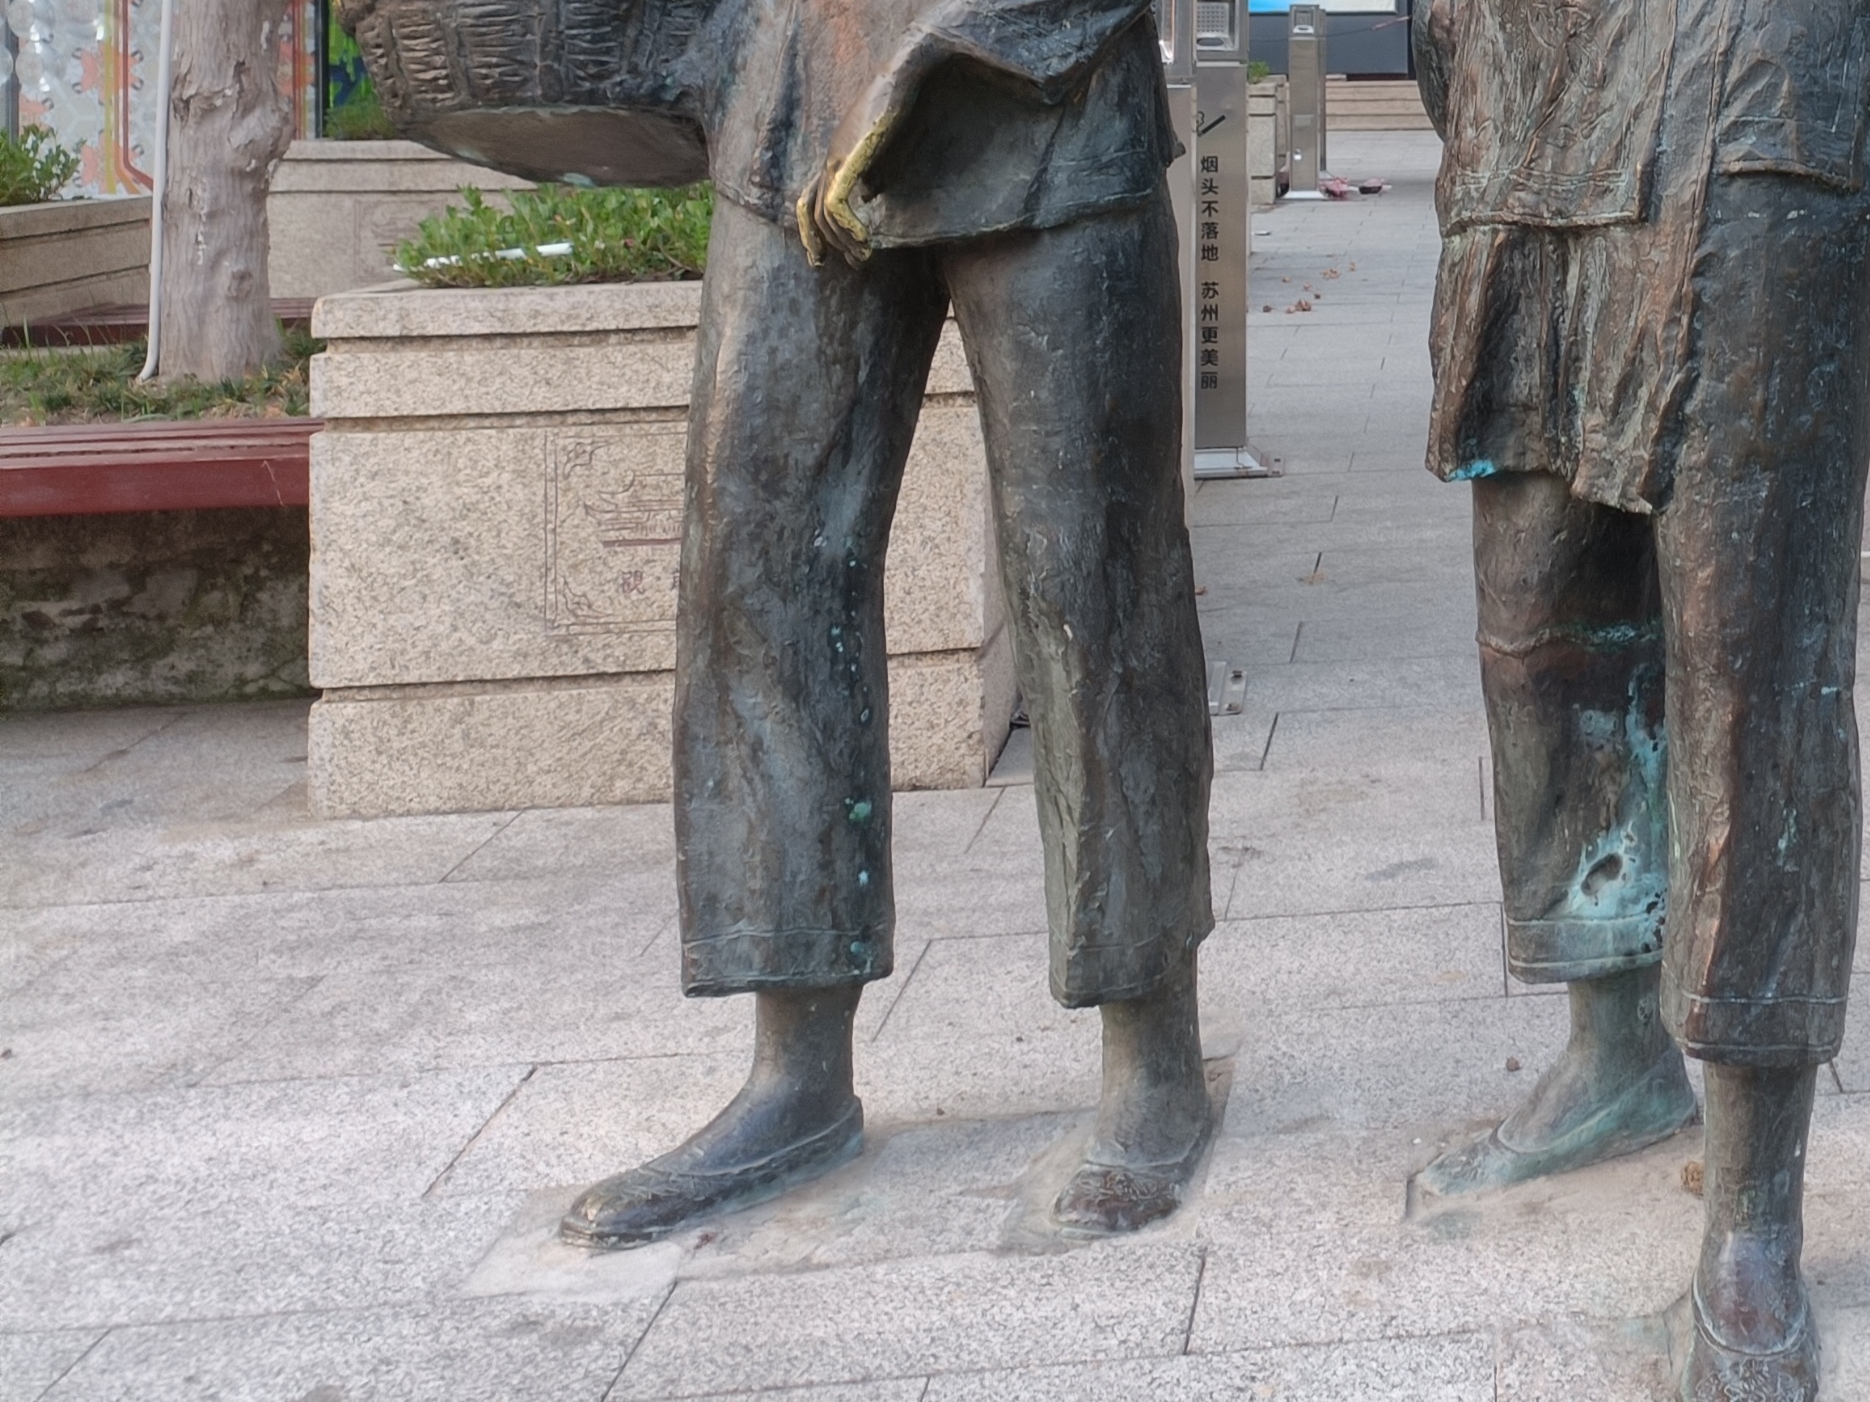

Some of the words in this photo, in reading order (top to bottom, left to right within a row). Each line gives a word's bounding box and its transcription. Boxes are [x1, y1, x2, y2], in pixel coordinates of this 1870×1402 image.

[1200, 155, 1219, 262] 烟头不落地
[1200, 281, 1219, 390] 苏州更美丽
